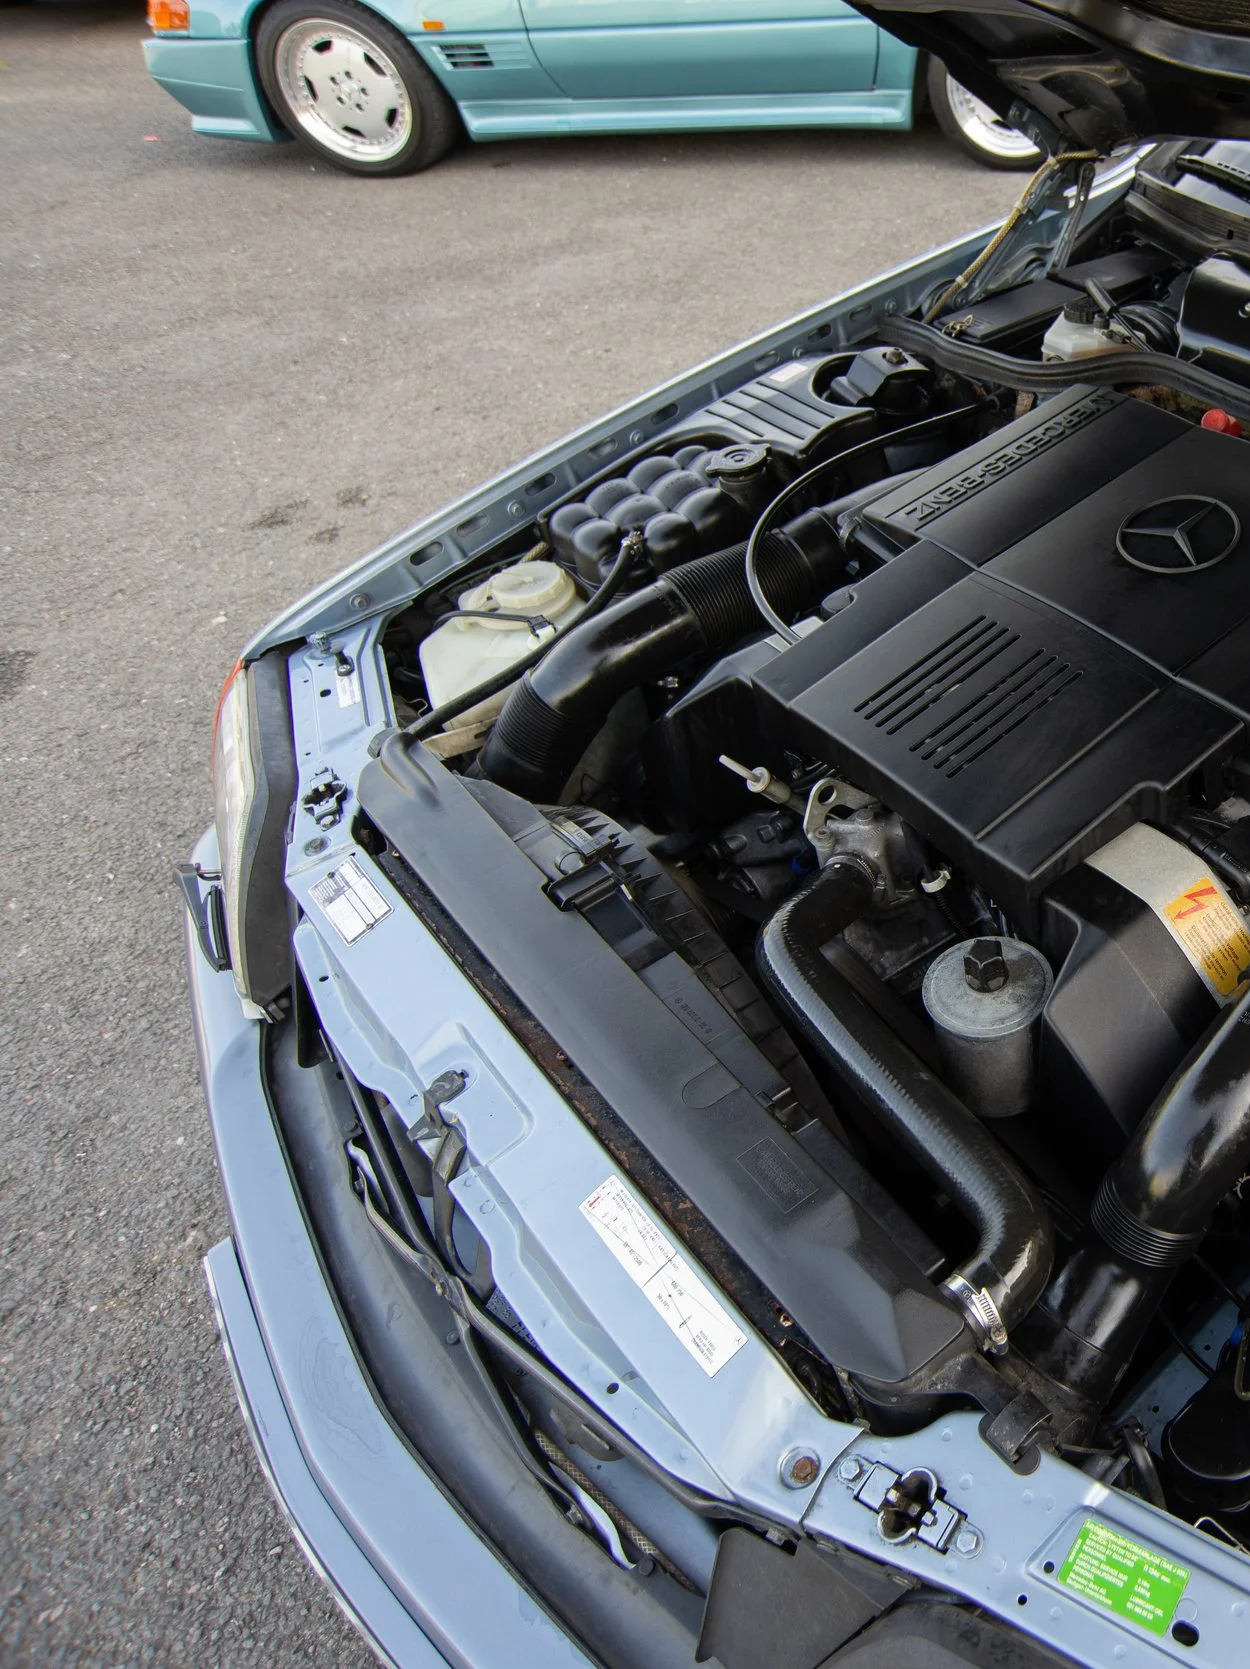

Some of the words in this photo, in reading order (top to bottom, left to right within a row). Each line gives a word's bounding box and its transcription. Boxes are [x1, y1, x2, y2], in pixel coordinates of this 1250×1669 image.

[904, 392, 1115, 521] MERCEDES-BENZ
[1225, 942, 1240, 961] voltage
[1213, 957, 1229, 977] tension
